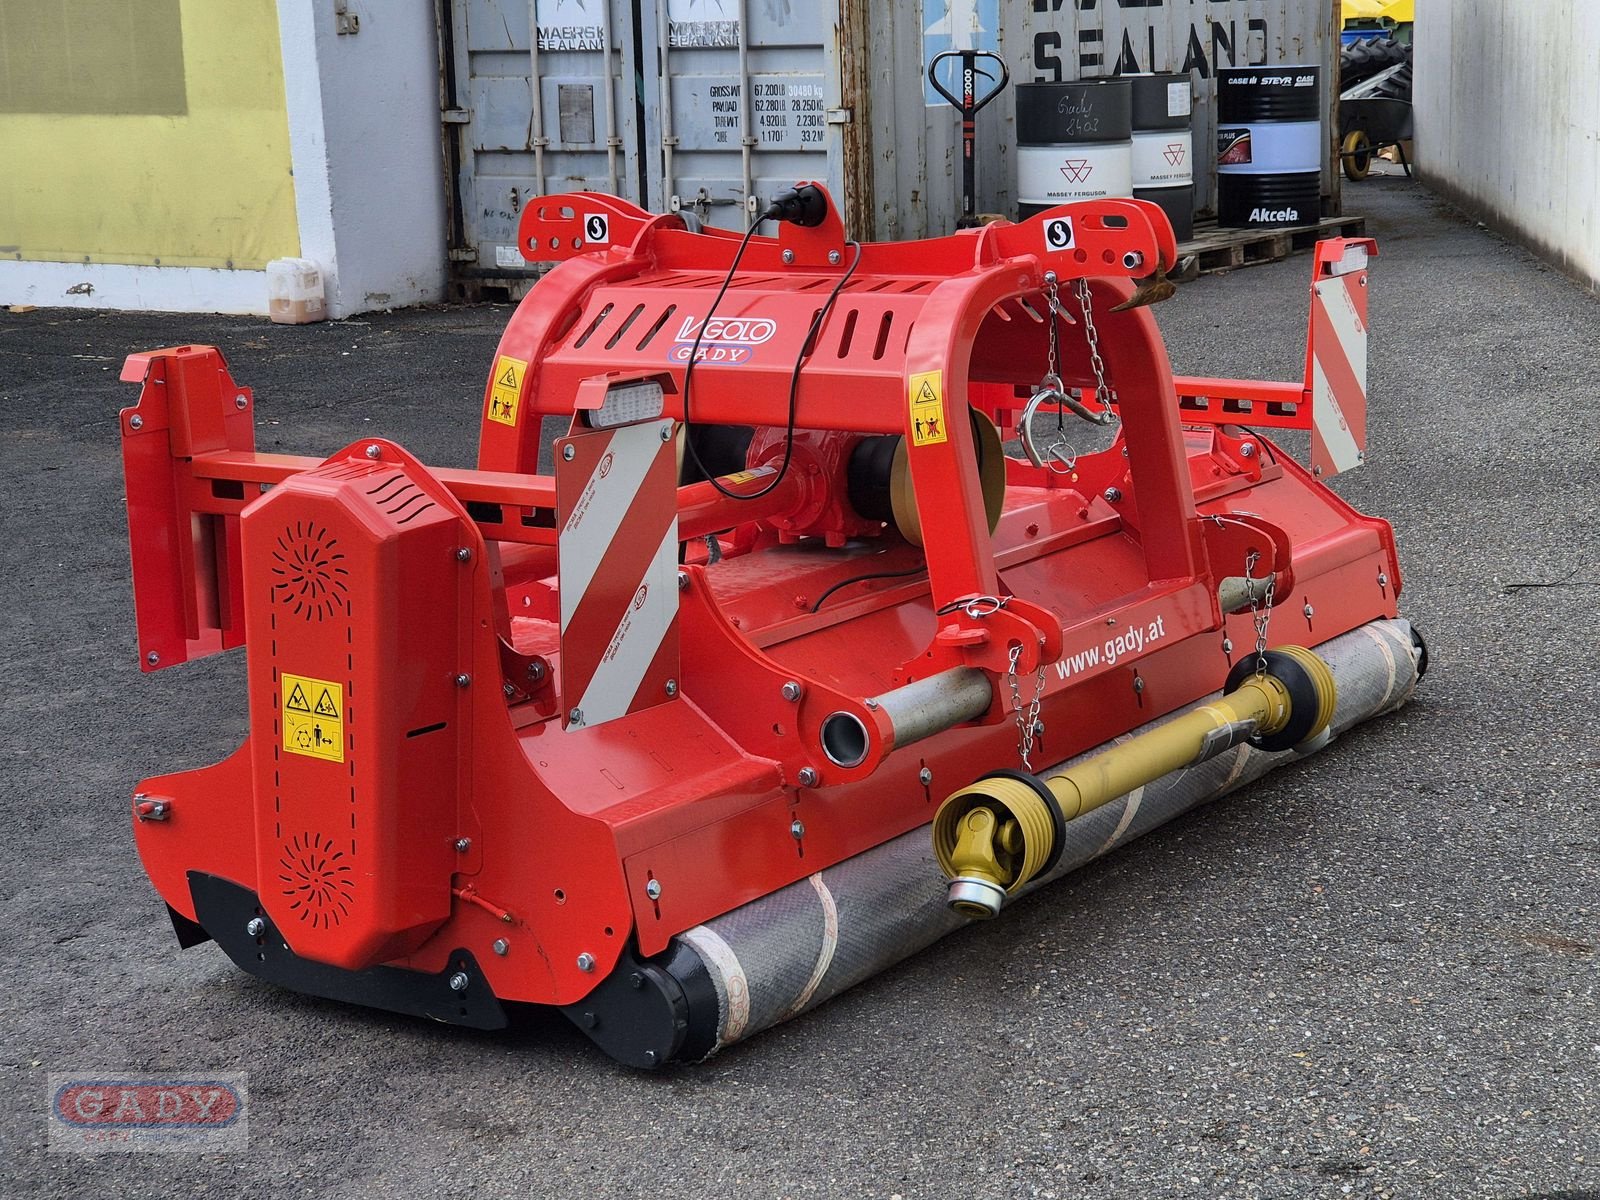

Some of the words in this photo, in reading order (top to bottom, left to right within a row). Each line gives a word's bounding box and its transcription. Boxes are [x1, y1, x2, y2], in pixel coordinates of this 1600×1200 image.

[1227, 77, 1249, 85] CASE
[1260, 76, 1293, 86] STEYR
[964, 68, 973, 110] TM2000
[712, 101, 737, 112] PAYLOAD
[1248, 206, 1299, 222] Akcela
[677, 347, 745, 361] GADY
[1055, 615, 1165, 680] www.gady.at
